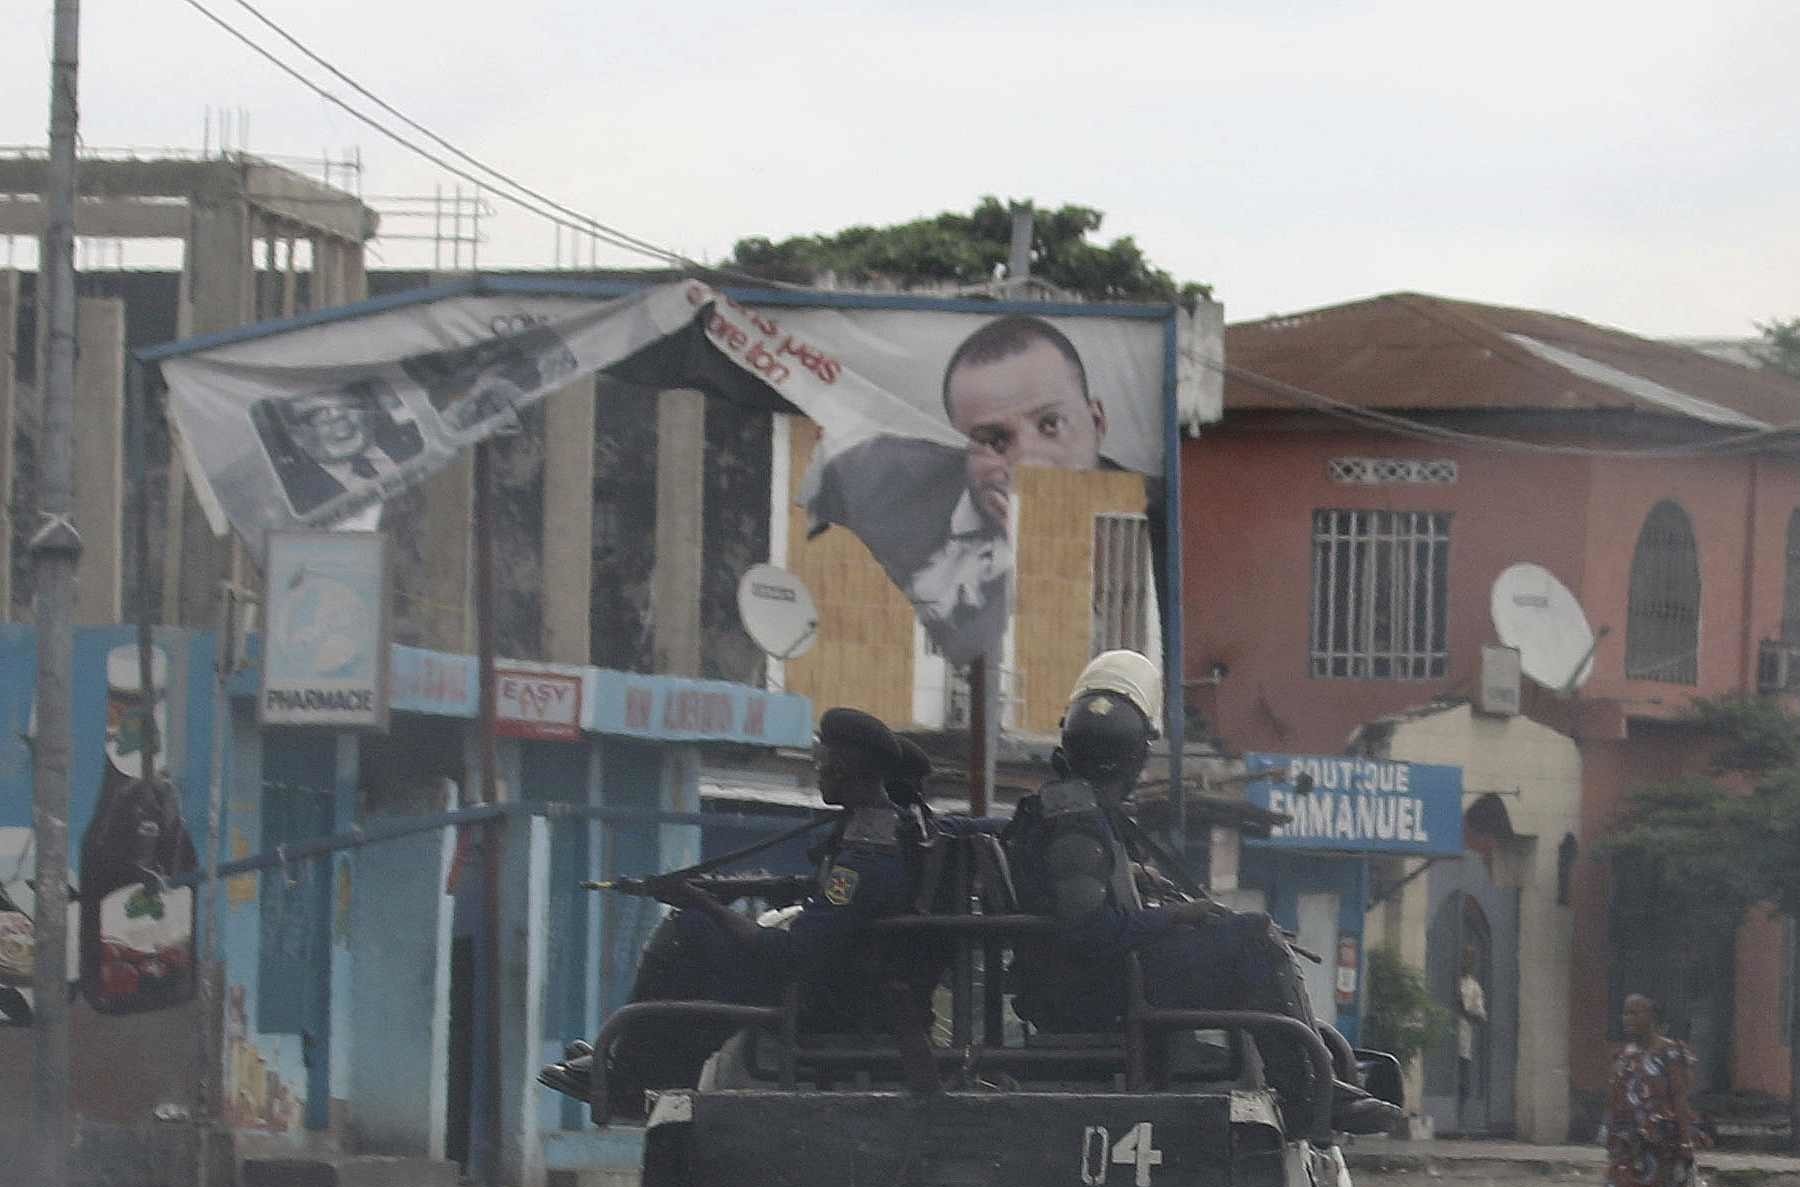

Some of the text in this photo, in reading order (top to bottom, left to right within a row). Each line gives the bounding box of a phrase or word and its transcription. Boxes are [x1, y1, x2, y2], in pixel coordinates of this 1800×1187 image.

[267, 689, 374, 711] PHARMACIE
[503, 682, 568, 702] EASY
[1269, 790, 1428, 842] EMMANUEL
[1081, 1122, 1162, 1187] 04
